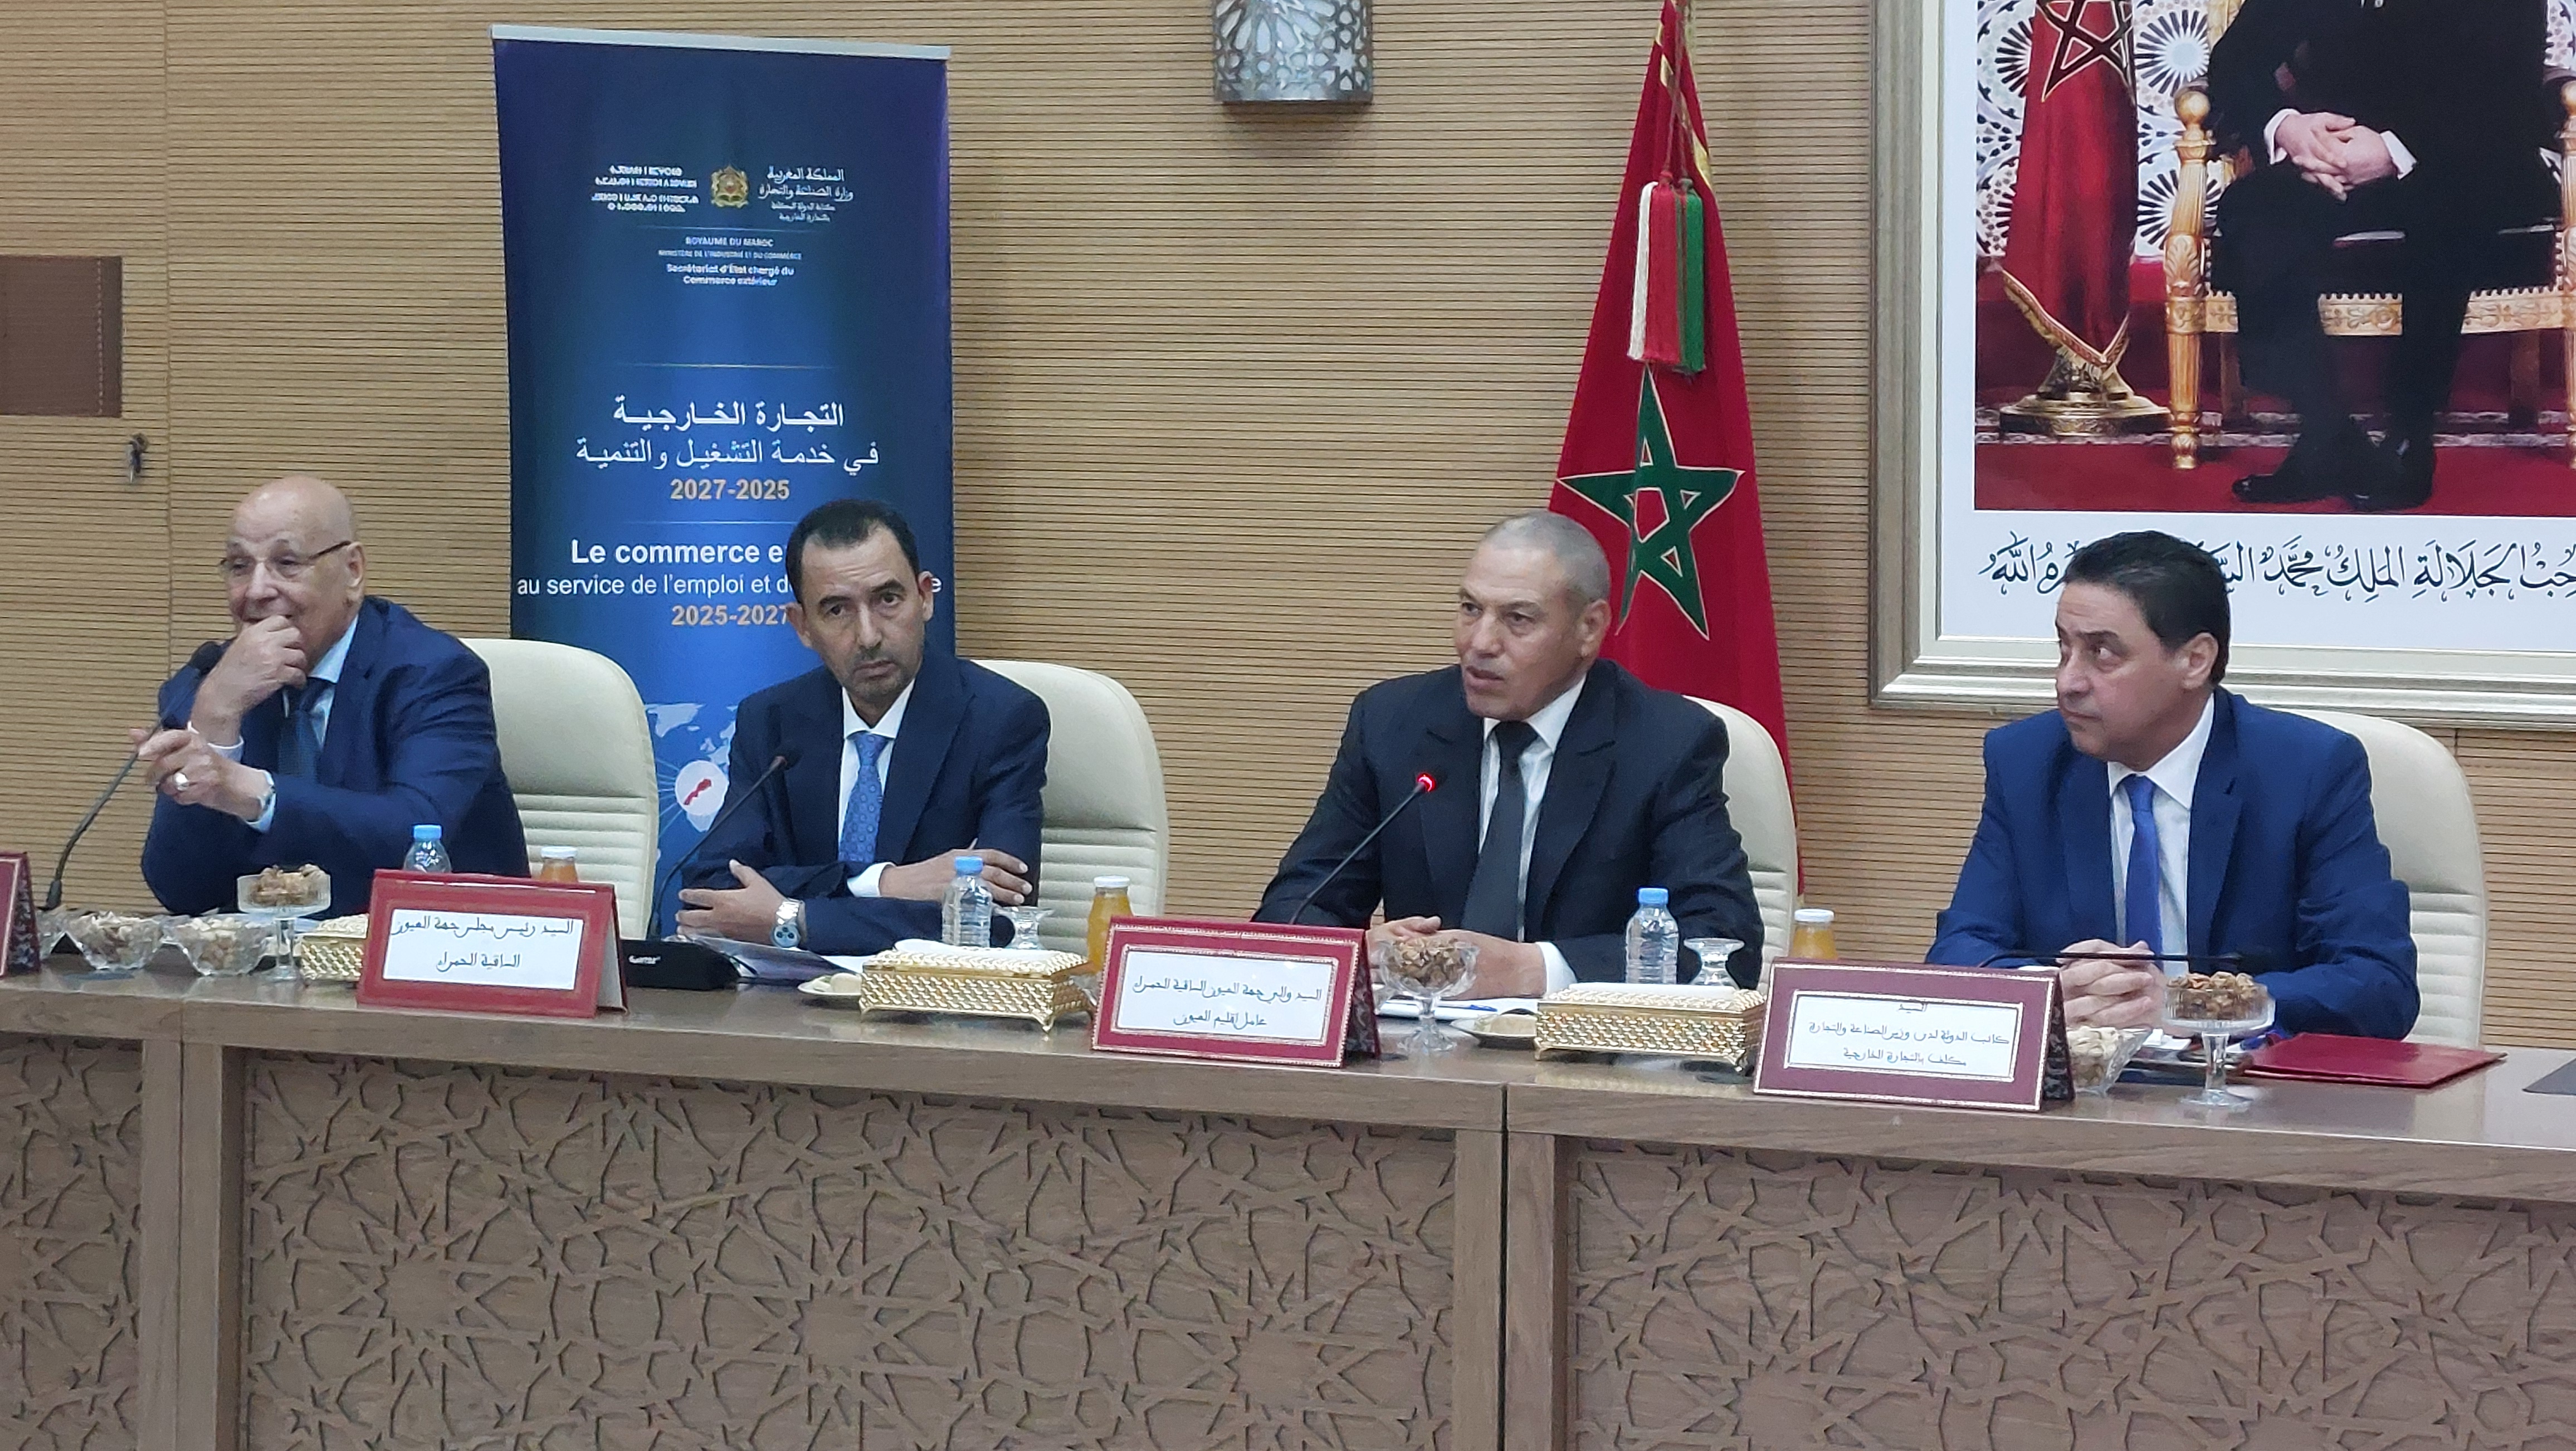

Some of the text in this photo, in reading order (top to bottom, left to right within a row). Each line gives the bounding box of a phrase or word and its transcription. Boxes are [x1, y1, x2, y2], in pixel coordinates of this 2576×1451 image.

[767, 165, 804, 184] المغربية
[685, 236, 774, 247] ROYAUME DU MAROC
[666, 263, 719, 274] Secrétariat
[748, 266, 779, 277] chargé
[780, 266, 795, 275] du
[683, 275, 778, 286] Commerce extérieur
[613, 394, 844, 432] التجارة الخارجية
[576, 437, 880, 476] في خدمة التشغيل والتنمية
[670, 478, 790, 500] 2027-2025
[572, 539, 606, 564] Le
[615, 543, 760, 564] commerce
[517, 578, 540, 595] au
[547, 573, 625, 595] service
[632, 573, 657, 595] de
[751, 573, 771, 594] et
[435, 917, 460, 930] جهة
[454, 917, 494, 938] مجلس
[494, 922, 536, 939] رئيس
[540, 919, 574, 937] السيد
[436, 951, 520, 972] الساقية الحمراء
[1173, 978, 1207, 992] الساقية
[1202, 982, 1240, 998] العيون
[1242, 984, 1265, 996] جهة
[1295, 989, 1322, 1001] السيد
[1233, 1011, 1267, 1030] عامل
[1809, 1021, 1846, 1036] والتجارة
[1850, 1023, 1887, 1035] الصناعة
[1882, 1028, 1910, 1040] وزير
[1940, 1030, 1968, 1044] الدولة
[1971, 1033, 2009, 1044] كاتب
[1843, 1047, 1884, 1061] الخارجية
[1887, 1051, 1924, 1065] بالتجارة
